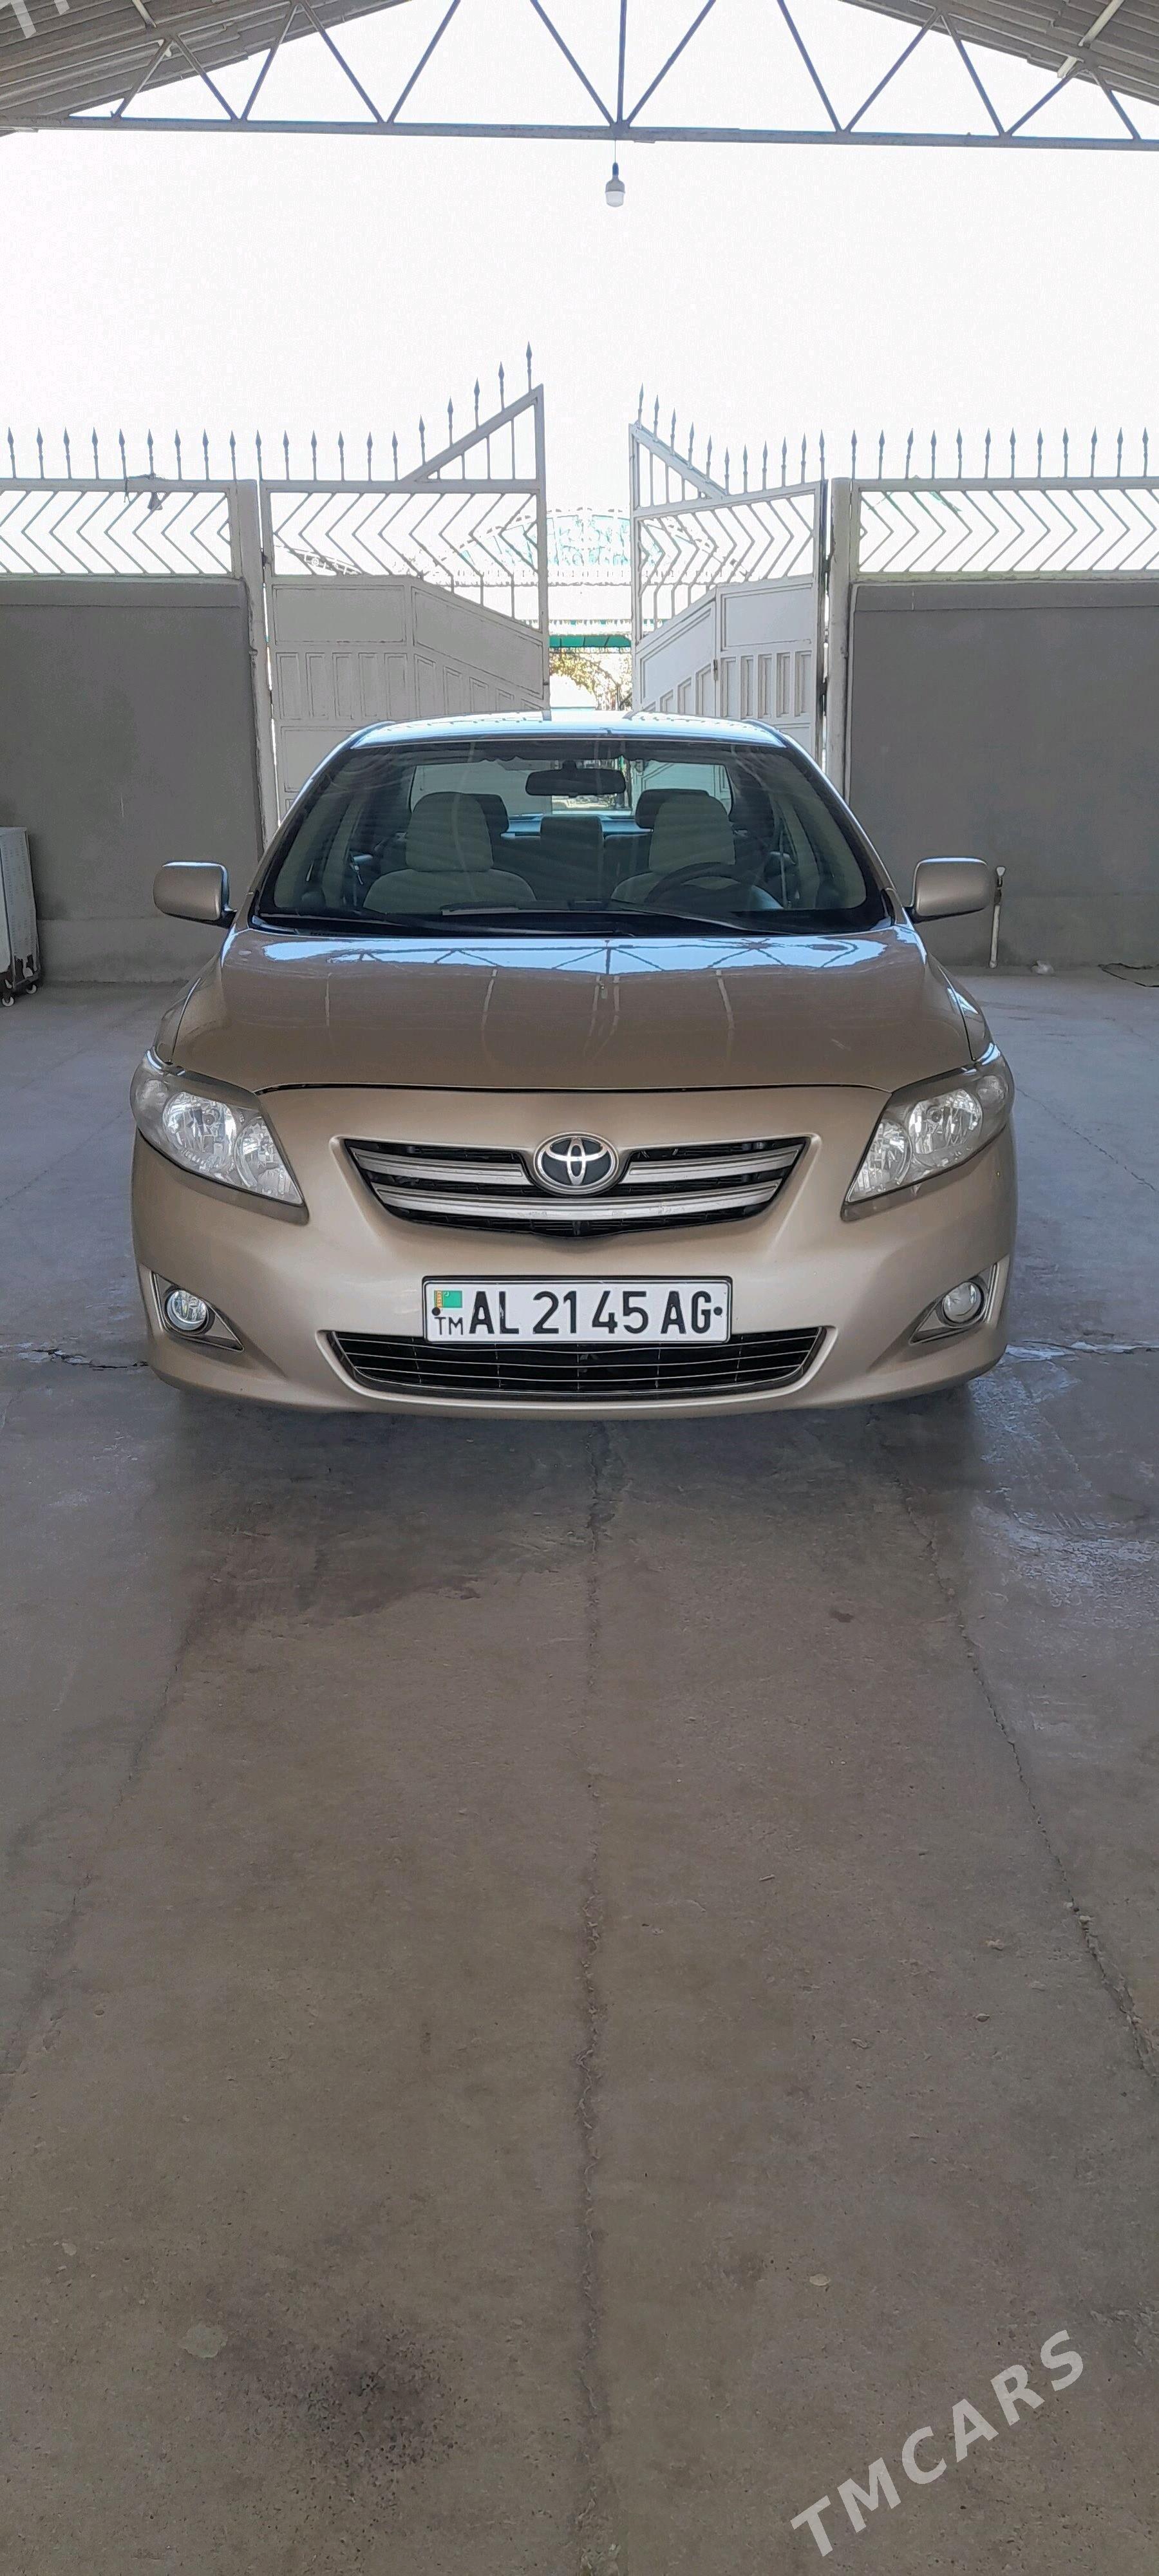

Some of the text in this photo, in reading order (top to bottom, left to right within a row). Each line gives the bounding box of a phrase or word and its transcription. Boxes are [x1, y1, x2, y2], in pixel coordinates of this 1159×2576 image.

[434, 1316, 464, 1335] TM
[469, 1291, 520, 1334] AL
[660, 1291, 711, 1334] AG
